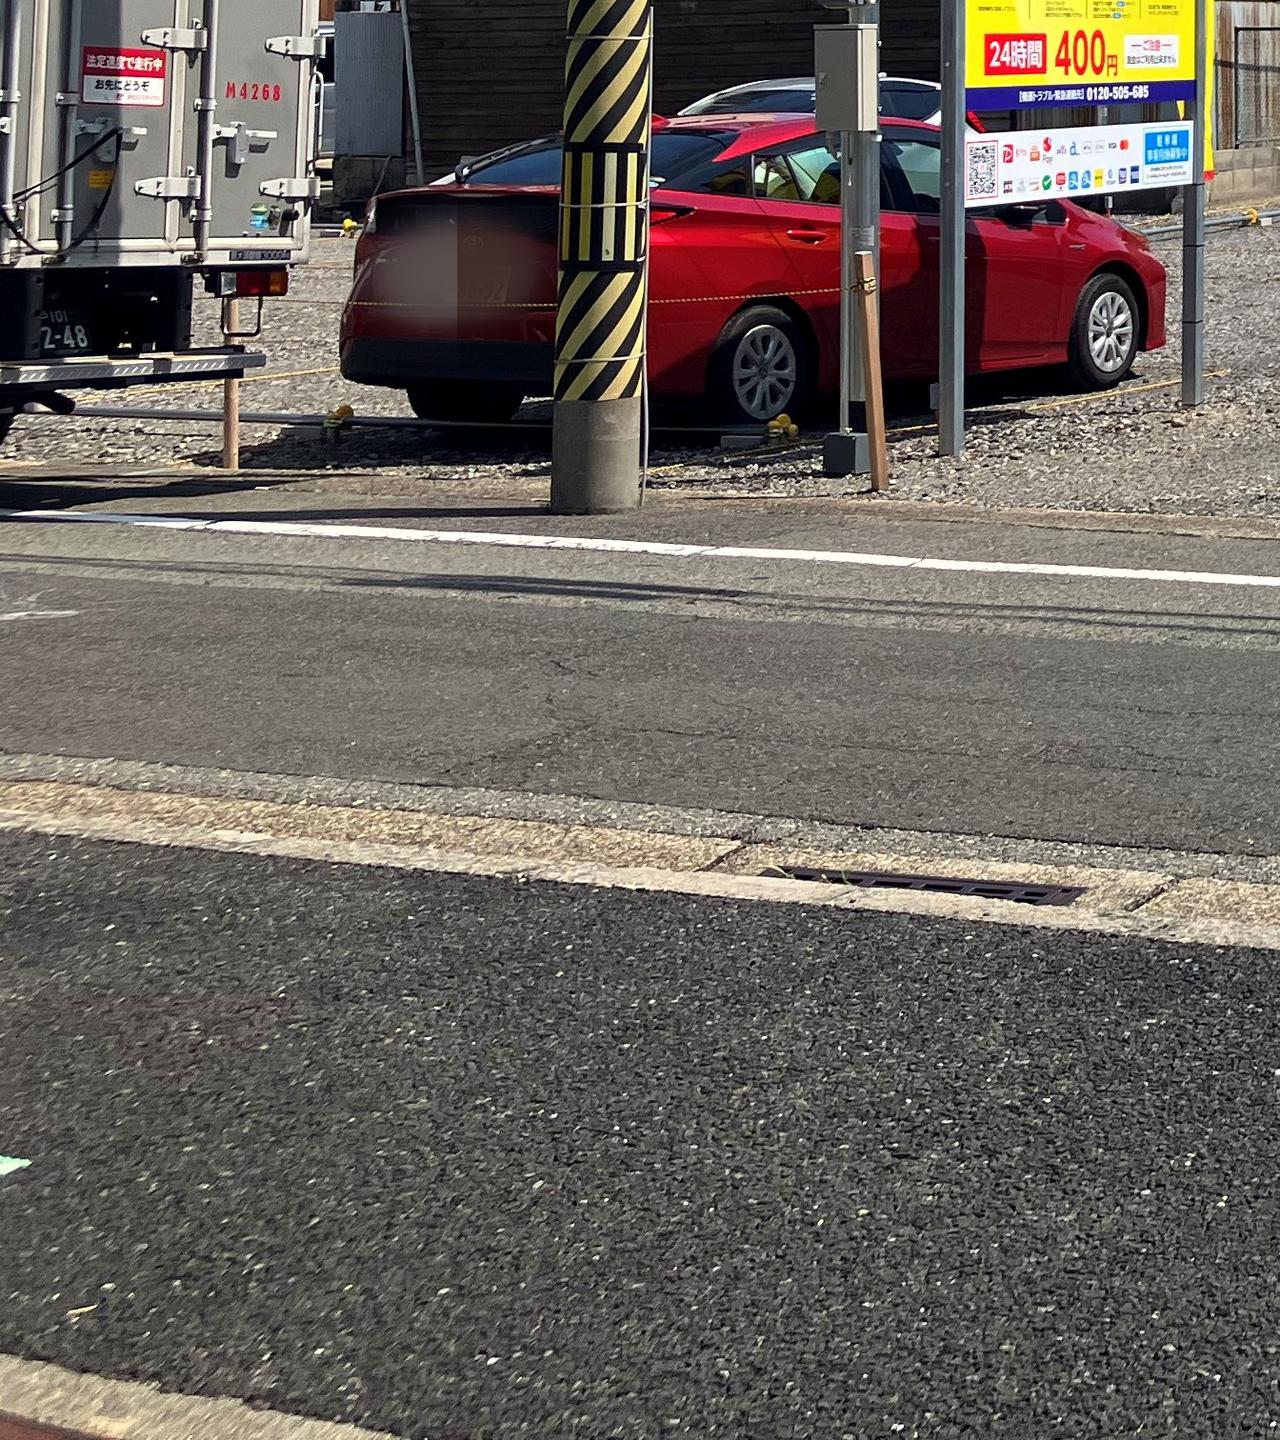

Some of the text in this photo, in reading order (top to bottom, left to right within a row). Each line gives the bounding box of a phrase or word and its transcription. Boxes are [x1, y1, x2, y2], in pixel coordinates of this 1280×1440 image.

[989, 39, 1043, 68] 24時間
[94, 79, 150, 91] お先にどうぞ
[225, 82, 281, 101] M4268
[1086, 85, 1149, 101] 0120-505-685
